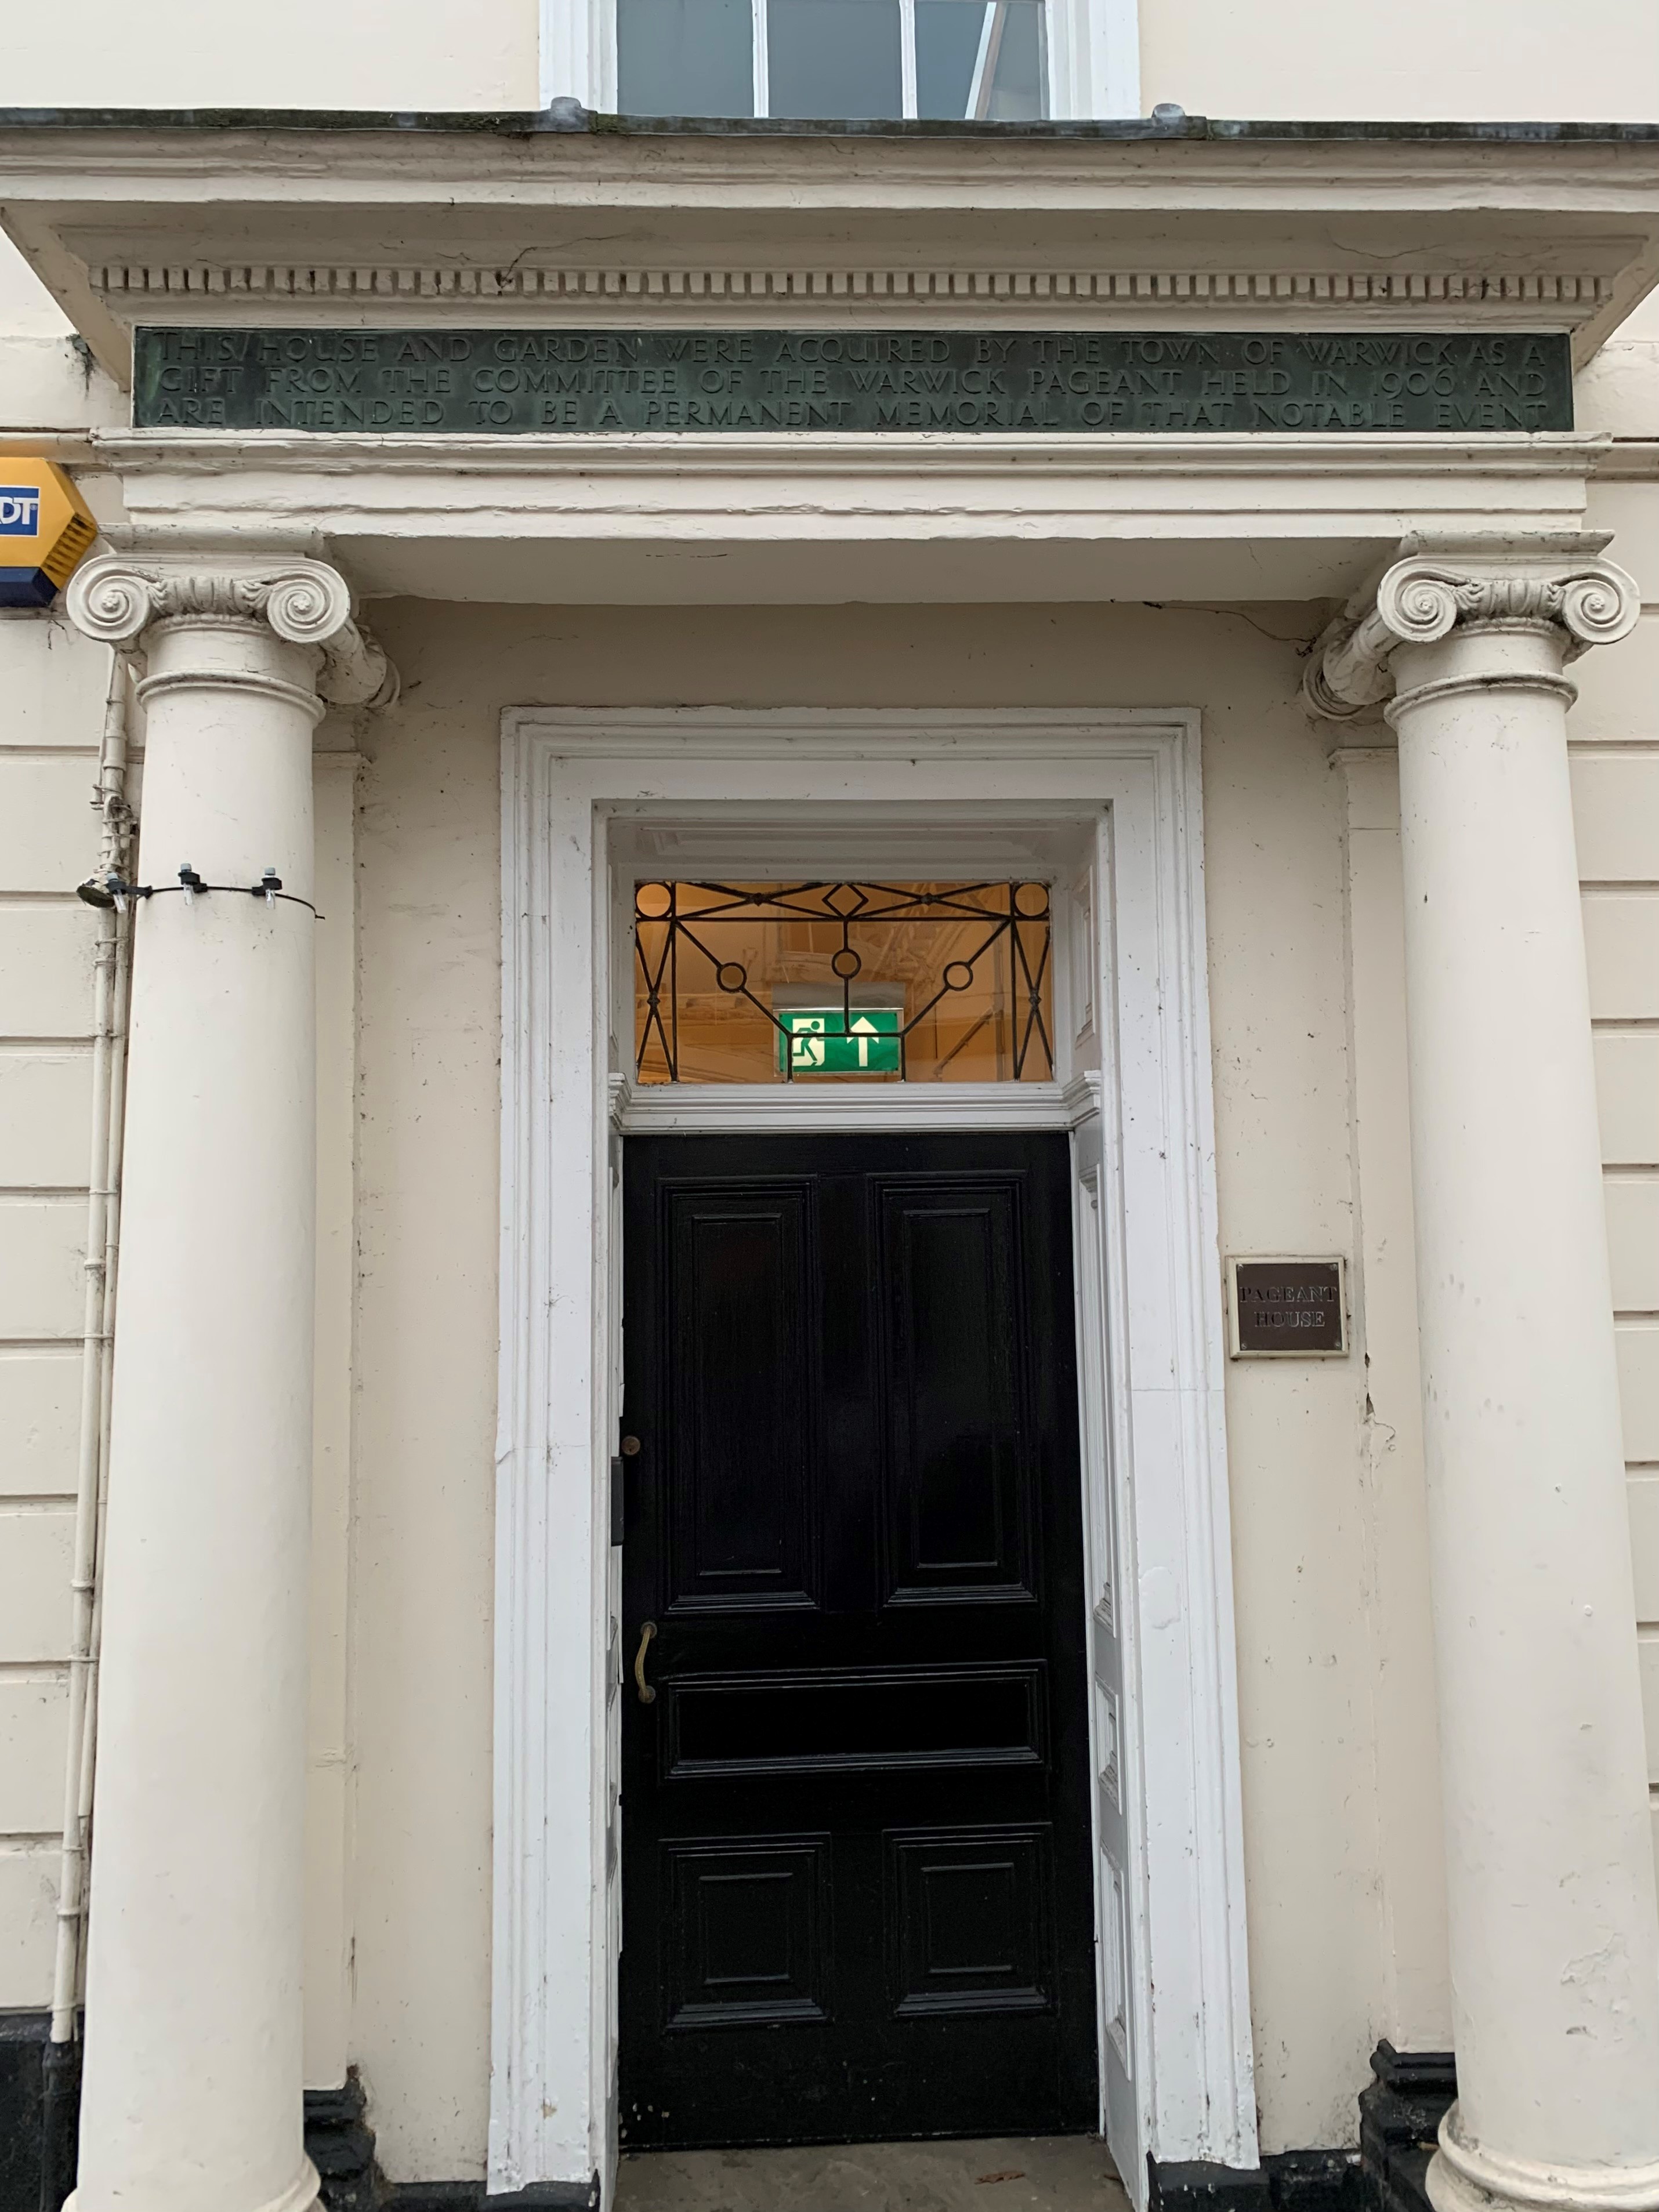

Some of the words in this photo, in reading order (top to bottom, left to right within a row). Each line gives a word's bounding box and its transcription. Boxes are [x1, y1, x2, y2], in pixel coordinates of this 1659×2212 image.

[153, 332, 237, 361] THIS
[258, 335, 378, 362] HOUSE
[397, 337, 472, 362] AND
[495, 338, 639, 362] GARDEN
[657, 339, 753, 363] WERE
[776, 339, 950, 364] ACQUIRED
[975, 339, 1017, 364] BY
[1031, 339, 1100, 364] THE
[1121, 340, 1220, 365] TOWN
[1244, 340, 1286, 365] OF
[1300, 341, 1455, 365] WARWICK
[1469, 341, 1505, 367] AS
[1524, 341, 1545, 367] A
[160, 366, 244, 393] GIFT
[263, 367, 361, 393] FROM
[380, 368, 451, 393] THE
[473, 368, 676, 394] COMMITTEE
[699, 369, 744, 394] OF
[759, 369, 828, 394] THE
[847, 369, 1008, 394] WARWICK
[1027, 370, 1183, 395] PAGEANT
[1202, 371, 1291, 396] HELD
[1312, 371, 1349, 396] IN
[1371, 367, 1454, 400] 1906
[1474, 372, 1545, 397] AND
[157, 397, 226, 425] ARE
[255, 398, 444, 425] INTENDED
[467, 400, 513, 425] TO
[541, 400, 578, 425] BE
[597, 400, 624, 425] A
[644, 401, 852, 426] PERMANENT
[874, 401, 1060, 426] MEMORIAL
[1082, 402, 1124, 426] OF
[1140, 402, 1234, 427] THAT
[1252, 402, 1405, 427] NOTABLE
[1434, 403, 1547, 427] EVENT
[0, 496, 38, 525] DT
[1240, 1286, 1337, 1303] PAGEANT
[1254, 1311, 1325, 1327] HOUSE
